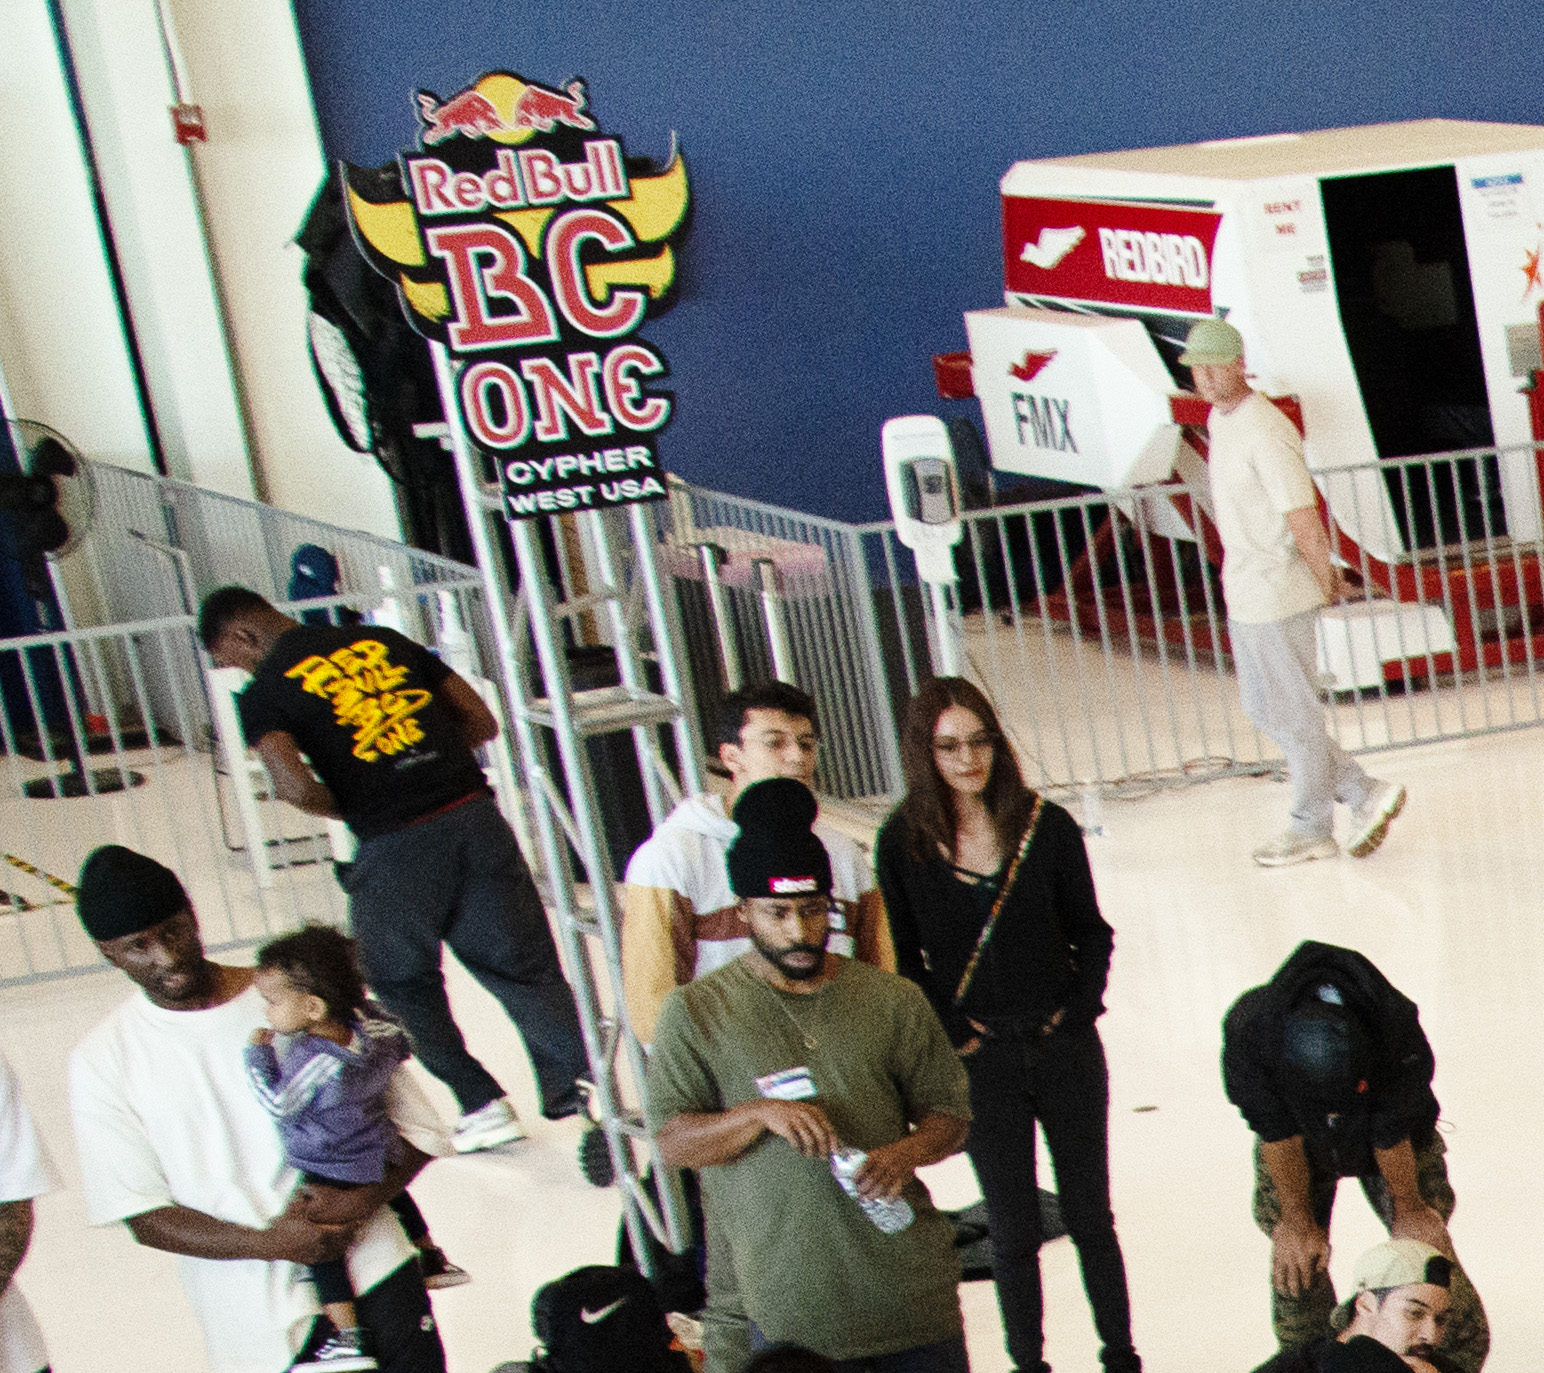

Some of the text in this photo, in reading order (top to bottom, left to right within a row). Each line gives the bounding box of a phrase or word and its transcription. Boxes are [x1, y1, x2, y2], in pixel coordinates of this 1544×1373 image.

[408, 138, 629, 215] Red Bull
[425, 207, 645, 351] BC
[1098, 227, 1209, 290] REDBIRD
[458, 344, 672, 450] ONE
[1011, 391, 1079, 454] FMX
[506, 446, 653, 486] CYPHER
[508, 477, 665, 515] WEST USA
